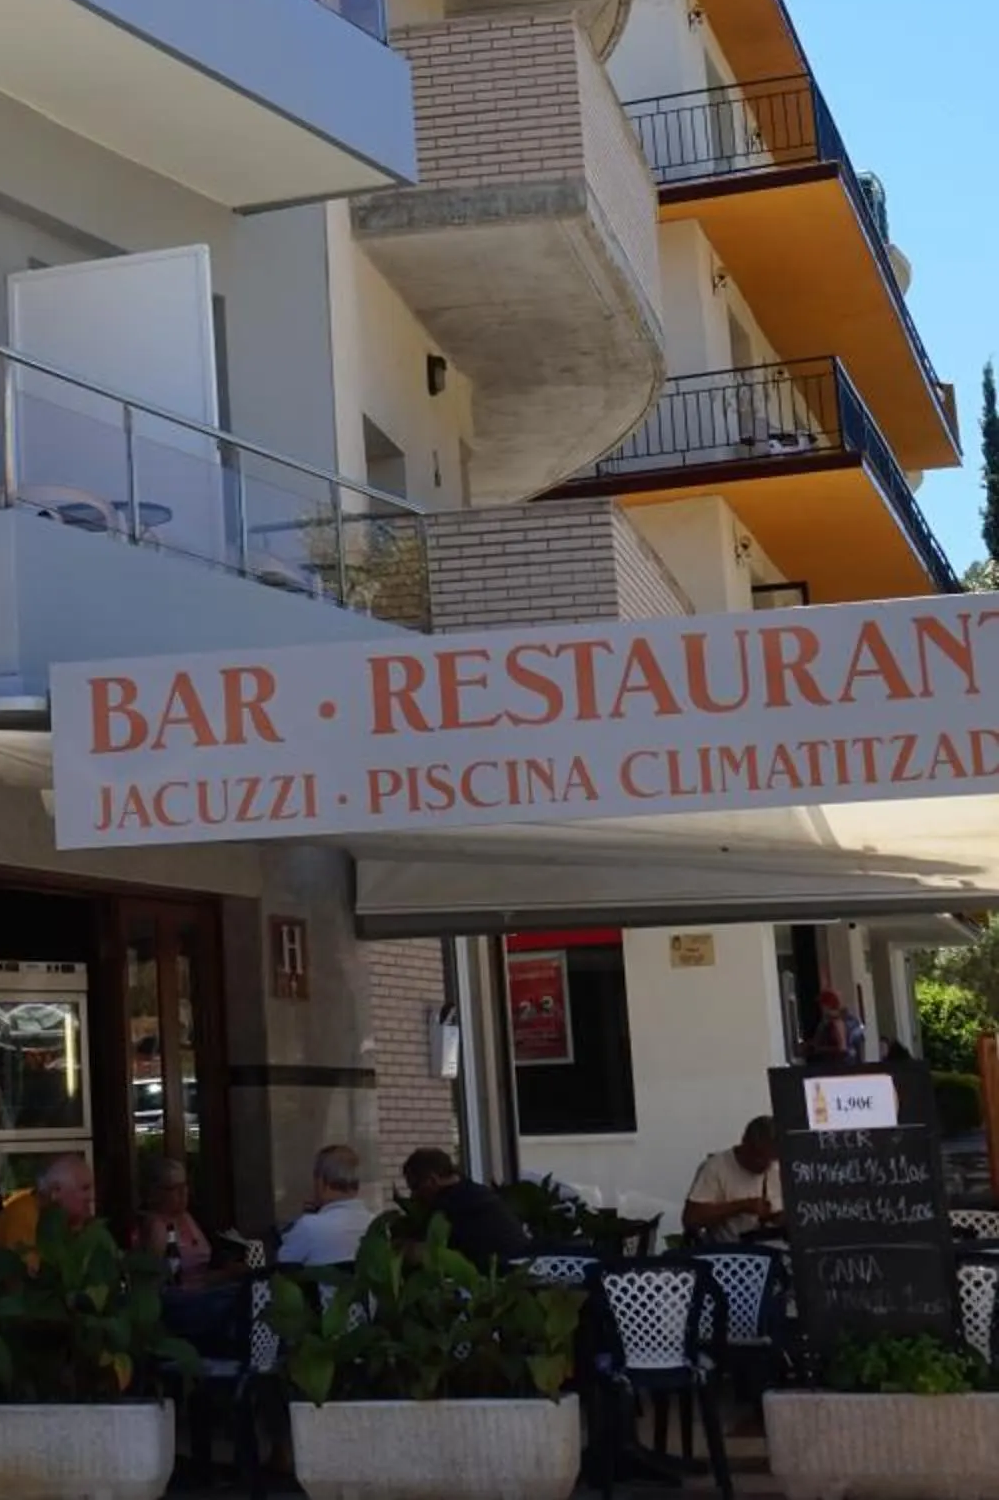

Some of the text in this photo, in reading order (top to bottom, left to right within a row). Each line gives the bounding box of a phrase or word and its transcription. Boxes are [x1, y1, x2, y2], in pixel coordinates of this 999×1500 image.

[88, 665, 284, 755] BAR
[94, 773, 317, 831] JACUZZI
[367, 755, 599, 816] PISCINA
